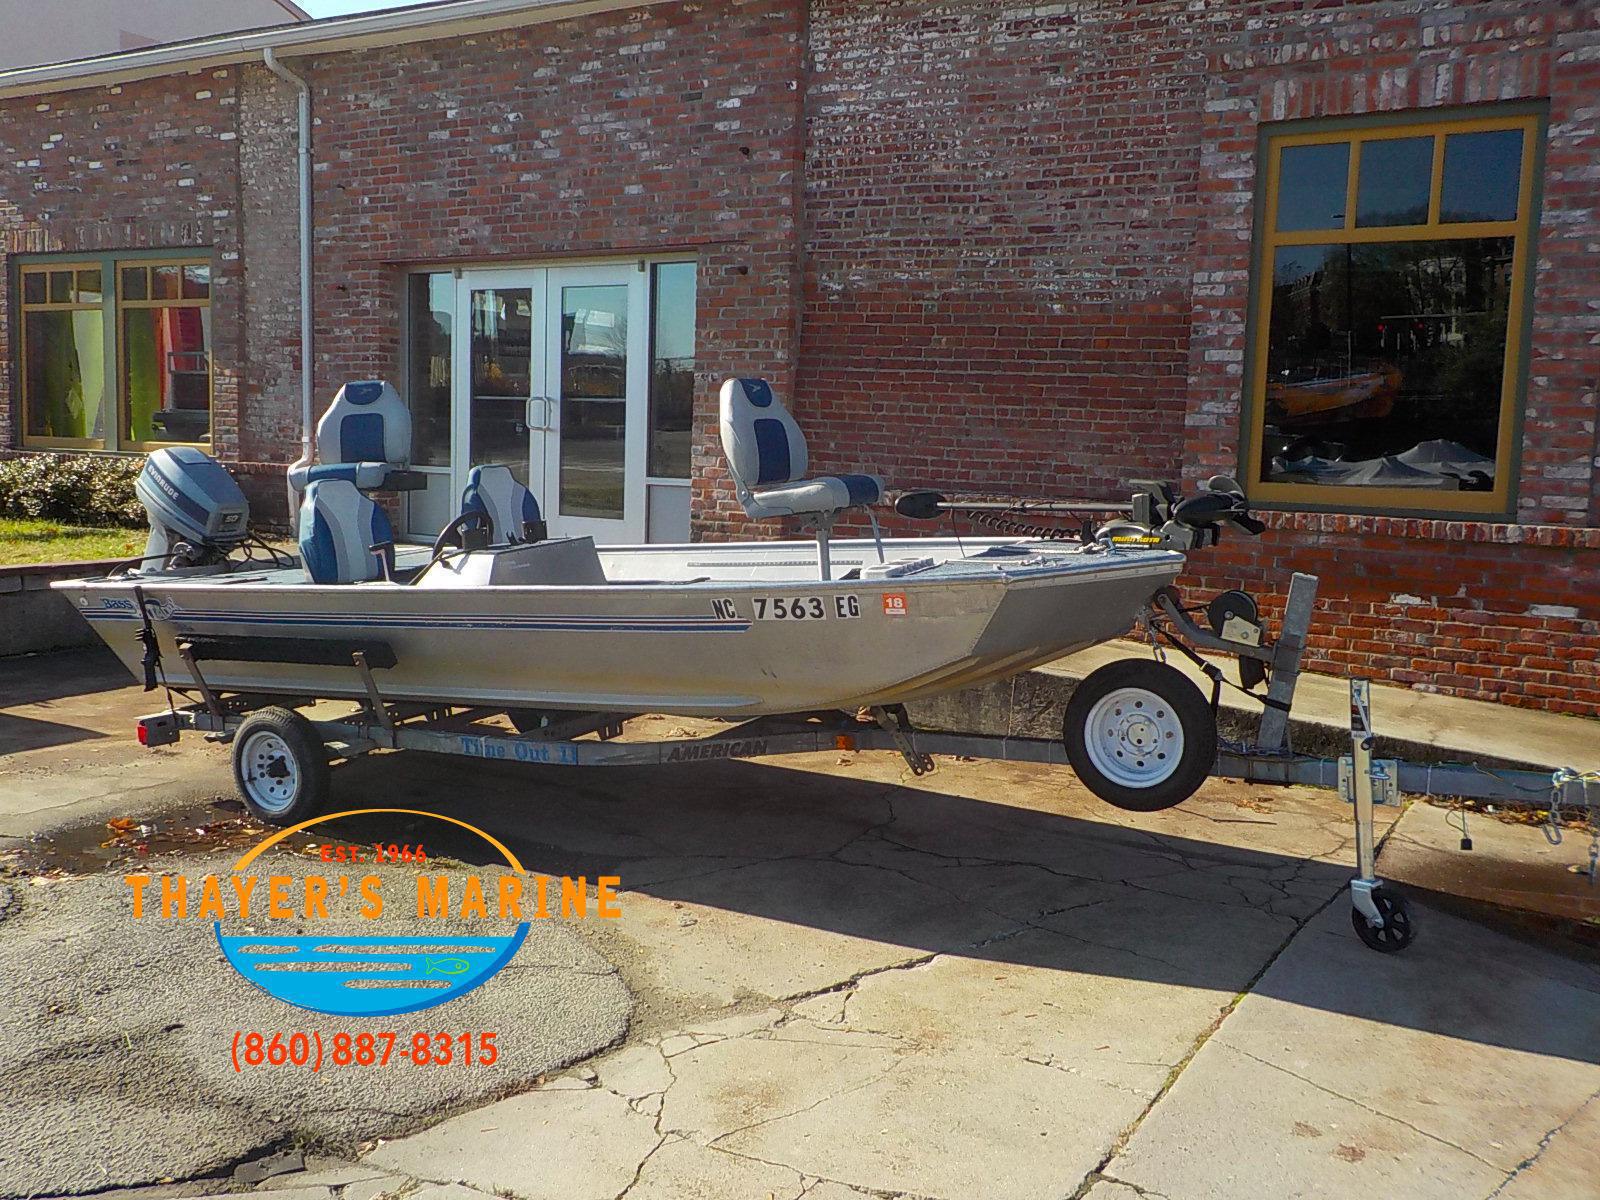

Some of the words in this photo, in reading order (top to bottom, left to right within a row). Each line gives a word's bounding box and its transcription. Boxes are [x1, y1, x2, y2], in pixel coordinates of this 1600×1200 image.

[147, 464, 179, 500] EVINRUDE
[711, 599, 736, 619] NC
[753, 598, 825, 619] 7563
[836, 596, 859, 618] EG
[885, 597, 903, 608] 18
[514, 742, 550, 761] Out
[667, 740, 768, 761] AMERICAN
